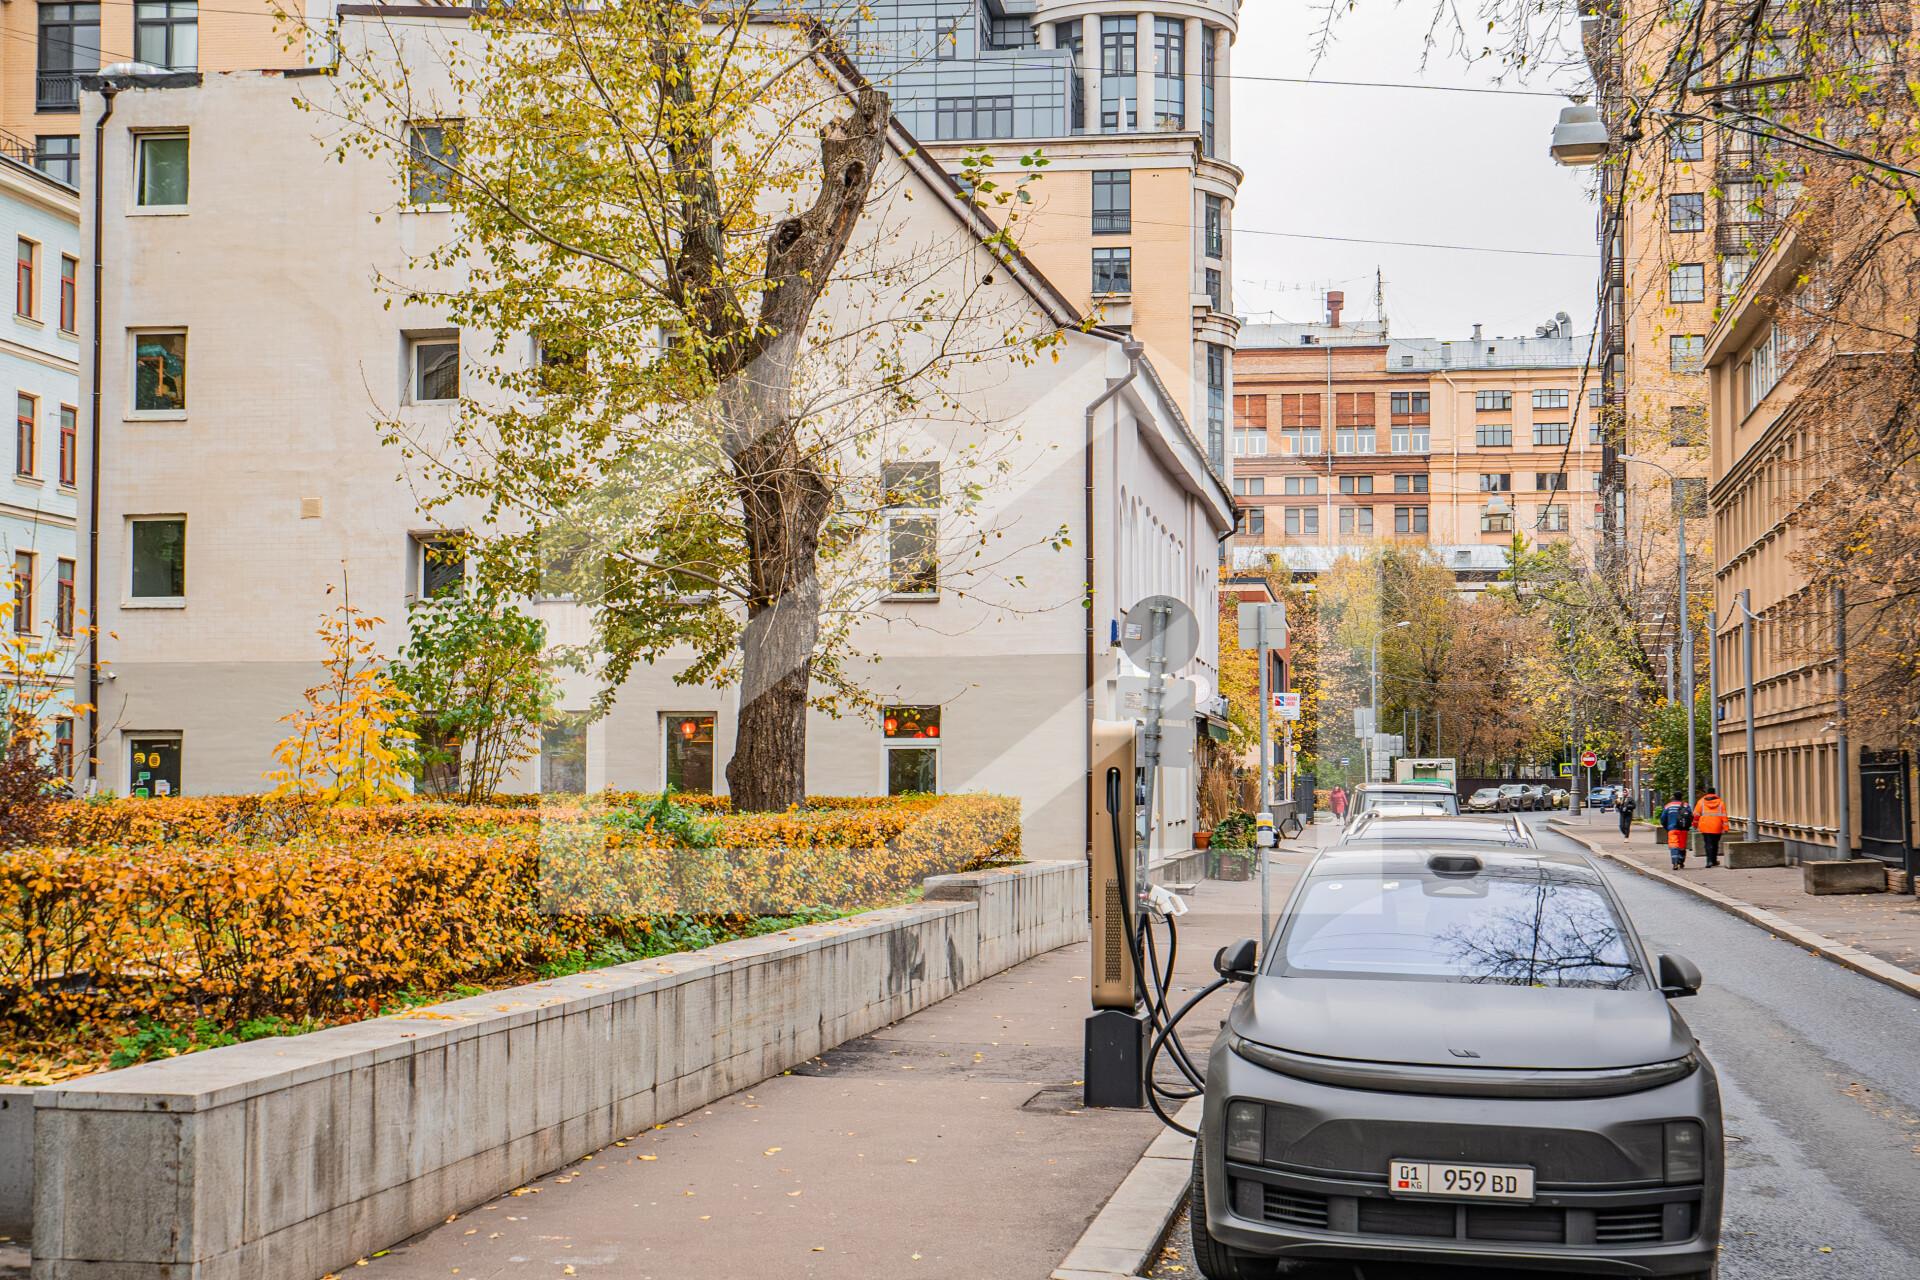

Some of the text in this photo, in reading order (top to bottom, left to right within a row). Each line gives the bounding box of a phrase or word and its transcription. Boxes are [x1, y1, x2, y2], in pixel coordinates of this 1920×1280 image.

[1400, 1166, 1419, 1180] 01
[1411, 1182, 1422, 1190] KG
[1444, 1169, 1517, 1194] 959 BD
